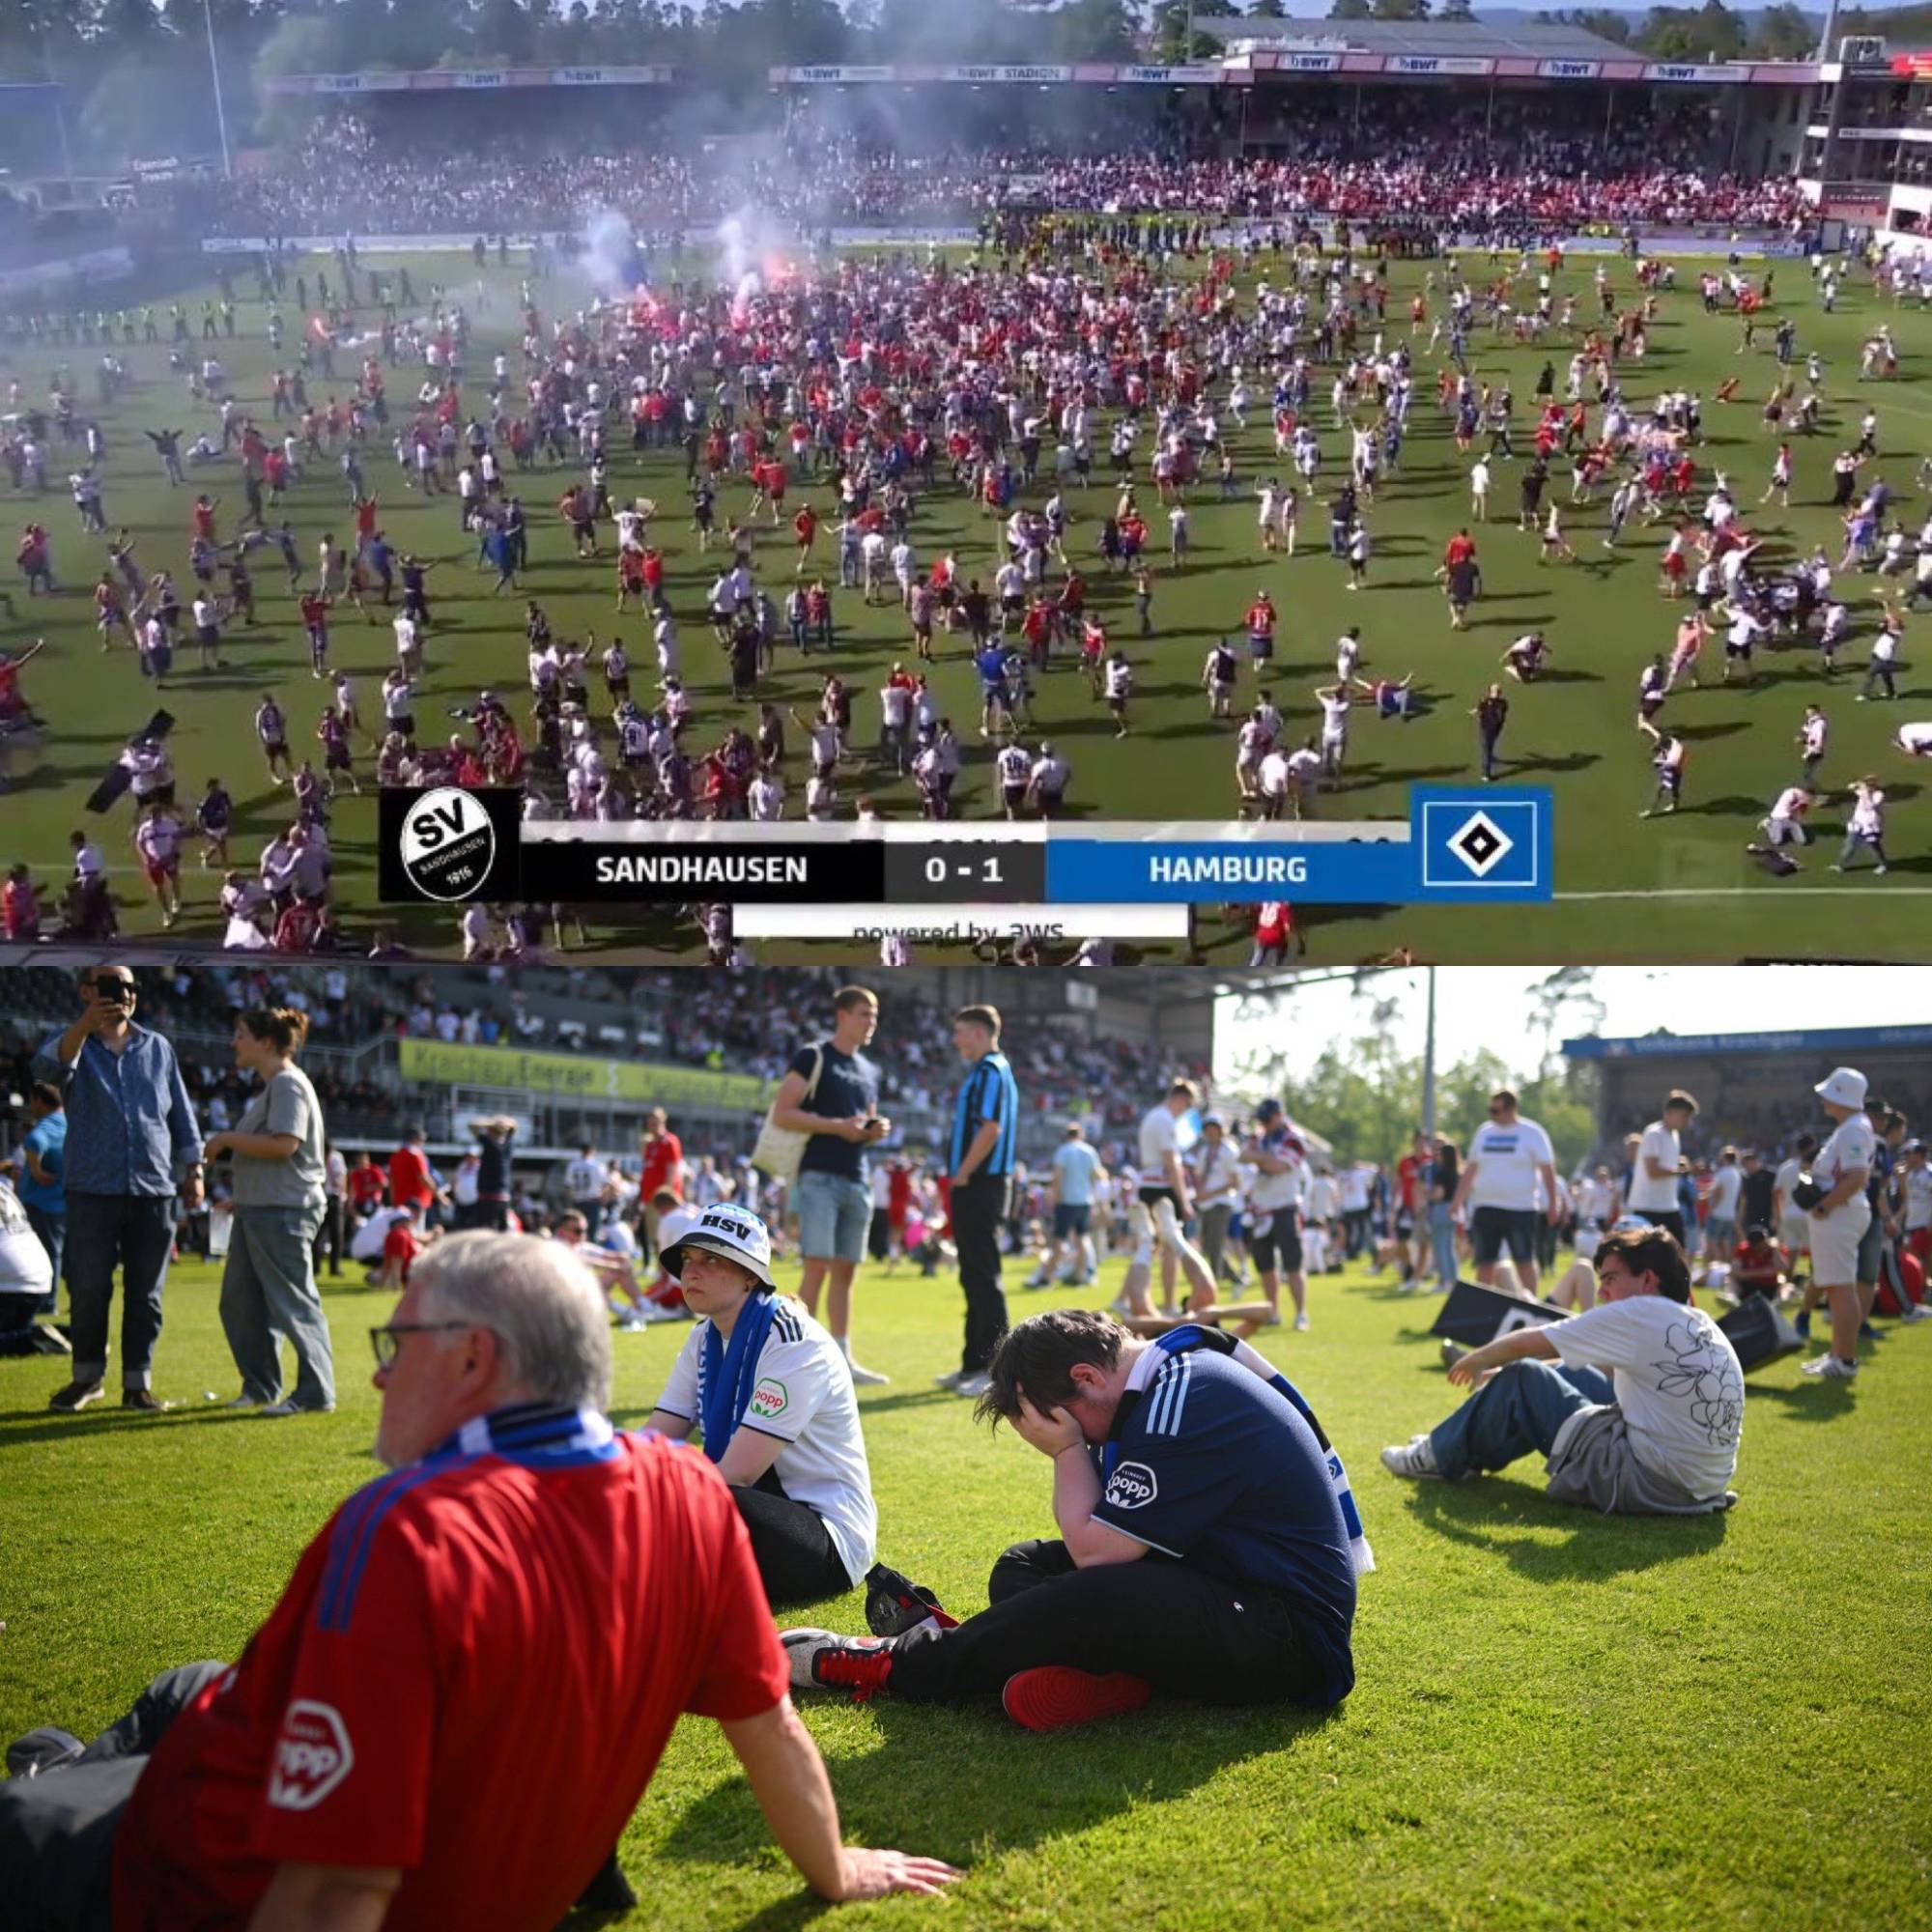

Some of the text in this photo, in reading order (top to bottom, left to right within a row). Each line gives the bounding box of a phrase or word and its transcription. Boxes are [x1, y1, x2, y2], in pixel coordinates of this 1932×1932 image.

[1004, 68, 1061, 79] STADION
[700, 1214, 752, 1241] HSV
[754, 1391, 783, 1408] popp
[1108, 1475, 1151, 1499] popp
